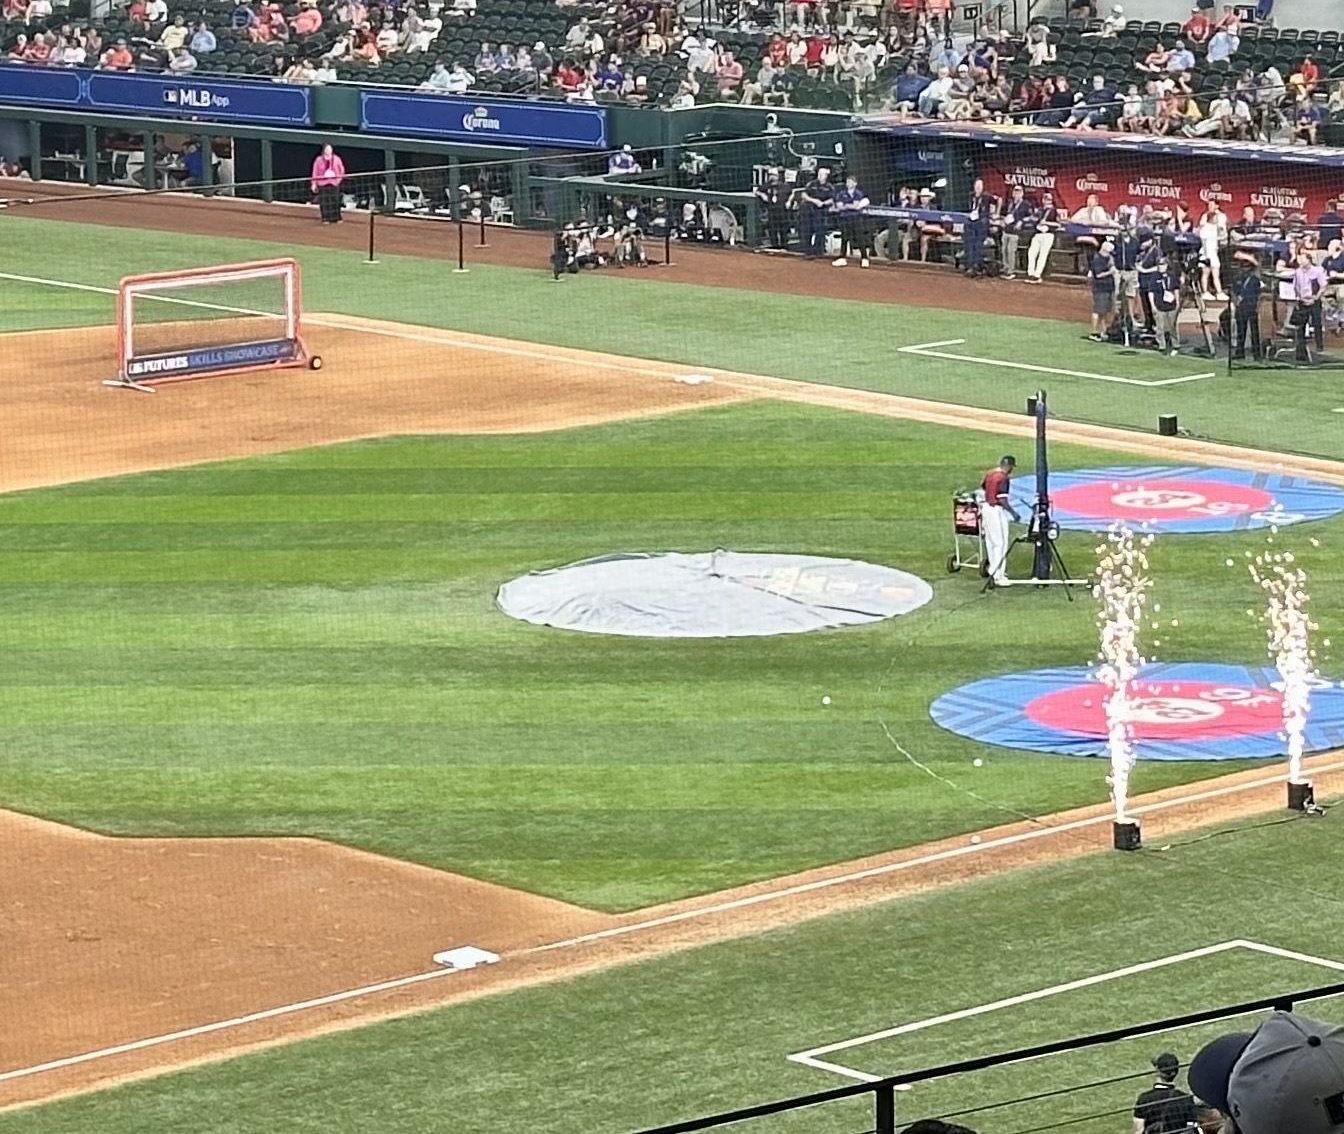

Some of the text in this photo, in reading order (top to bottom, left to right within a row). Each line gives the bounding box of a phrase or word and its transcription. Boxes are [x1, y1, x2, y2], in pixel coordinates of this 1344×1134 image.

[179, 88, 230, 108] MLB App
[462, 113, 500, 132] Corona
[1004, 173, 1056, 189] SATURDAY
[1076, 178, 1108, 192] Corona
[1128, 182, 1181, 199] SATURDAY
[1250, 193, 1308, 209] SATURDAY
[143, 344, 280, 373] FUTURES SKILLS SHOWCASE
